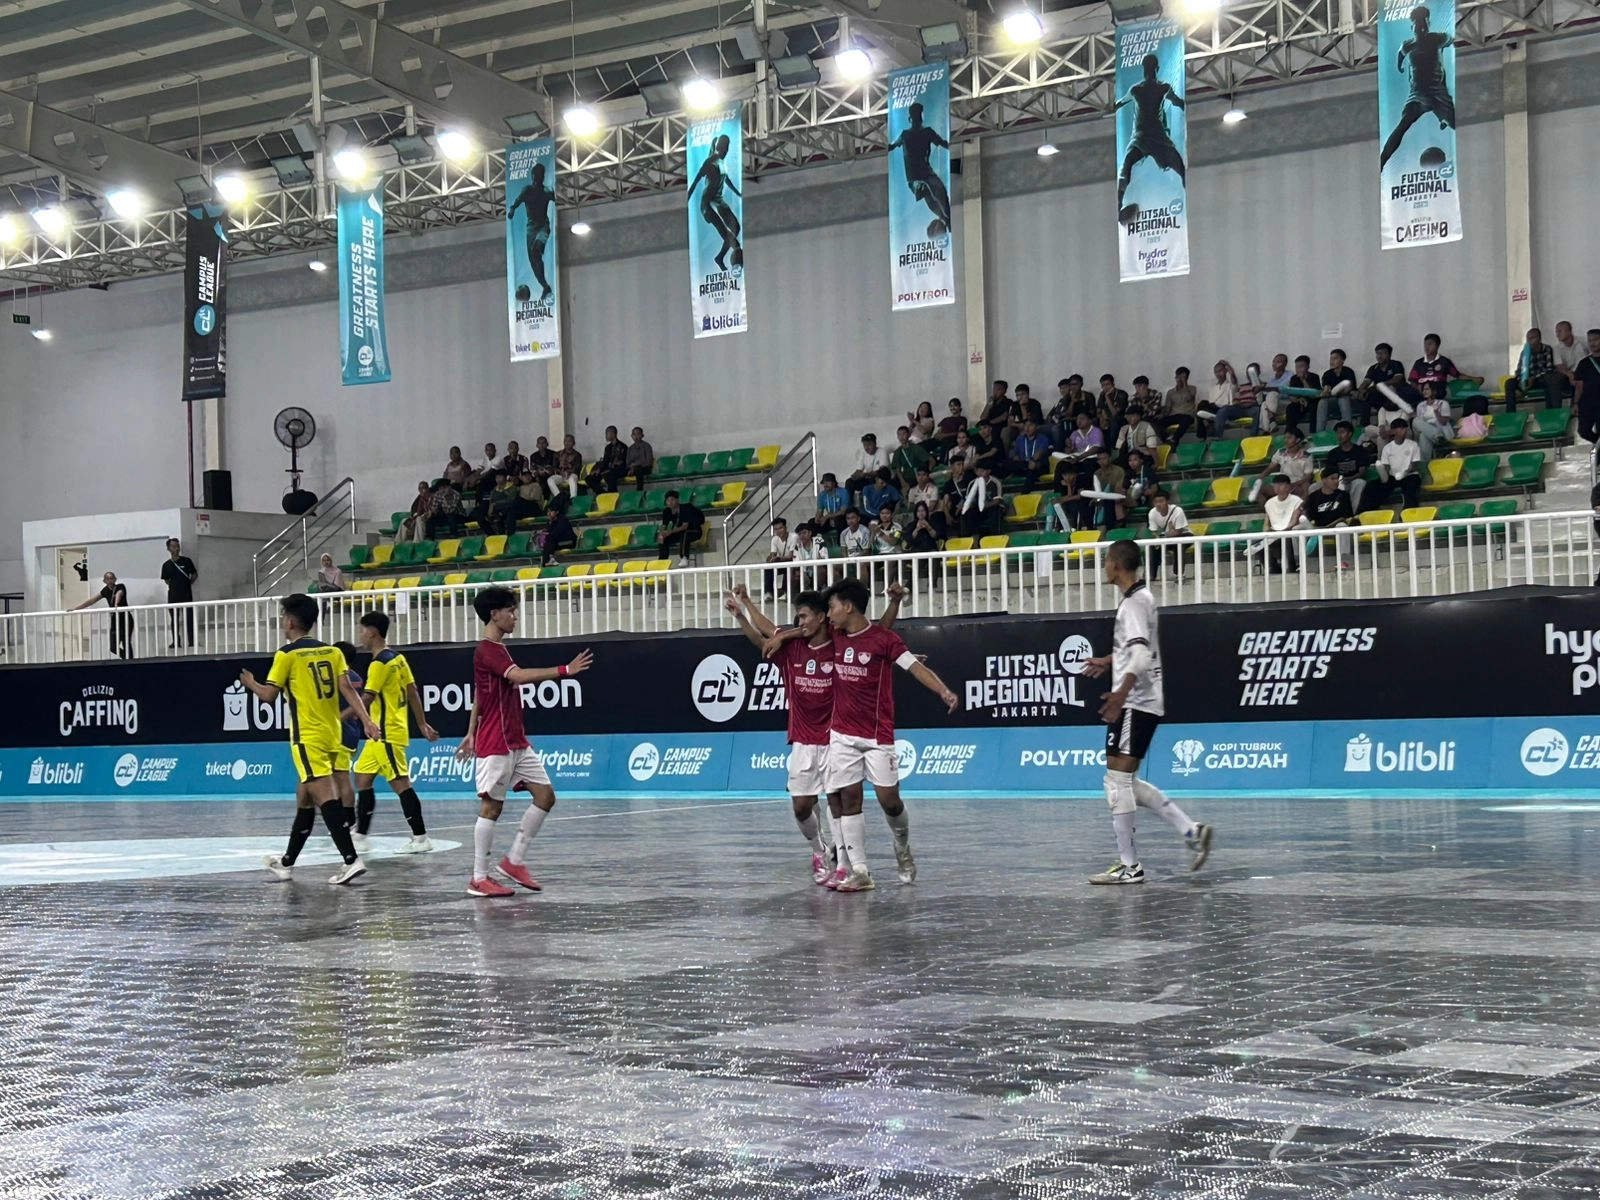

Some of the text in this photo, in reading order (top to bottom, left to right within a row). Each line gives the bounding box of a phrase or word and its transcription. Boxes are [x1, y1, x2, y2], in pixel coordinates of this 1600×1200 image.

[1121, 25, 1178, 46] GREATNESS
[1121, 40, 1160, 57] STARTS
[892, 69, 945, 88] GREATNESS
[892, 83, 928, 98] STARTS
[510, 157, 538, 171] STARTS
[1401, 170, 1440, 184] FUTSAL
[1391, 180, 1452, 200] REGIONAL
[1137, 207, 1170, 221] FUTSAL
[1128, 217, 1180, 236] REGIONAL
[906, 241, 937, 253] FUTSAL
[899, 250, 946, 267] REGIONAL
[1139, 249, 1168, 262] hydro
[362, 216, 378, 329] STARTS HERE
[1145, 259, 1167, 271] plus
[199, 255, 207, 301] CAMPUS
[205, 261, 215, 304] LEAGUE
[705, 271, 732, 283] FUTSAL
[351, 242, 364, 338] GREATNESS
[699, 280, 741, 297] REGIONAL
[898, 289, 948, 302] POLYTRON
[522, 300, 546, 310] FUTSAL
[515, 307, 553, 323] REGIONAL
[712, 313, 740, 329] blibli
[1237, 627, 1377, 655] GREATNESS
[985, 653, 1062, 678] FUTSAL
[1238, 655, 1331, 680] STARTS
[307, 660, 335, 699] 19
[82, 685, 114, 698] DELIZIO
[423, 678, 582, 712] POLRON
[698, 679, 736, 704] CL
[965, 676, 1086, 711] REGIONAL
[1240, 682, 1304, 706] HERE
[992, 705, 1058, 718] JAKARTA
[1107, 731, 1116, 746] 2
[1212, 742, 1282, 751] KOPI TUBRUK
[663, 748, 712, 761] CAMPUS
[921, 745, 976, 759] CAMPUS
[1020, 750, 1107, 767] POLYTRO
[1376, 741, 1456, 772] blibli
[1525, 746, 1559, 763] CL
[141, 758, 178, 769] CAMPUS
[631, 757, 654, 771] CL
[658, 762, 703, 775] LEAGUE
[916, 760, 966, 774] LEAGUE
[1204, 753, 1288, 769] GADJAH
[44, 763, 84, 784] blibli
[136, 770, 170, 781] LEAGUE
